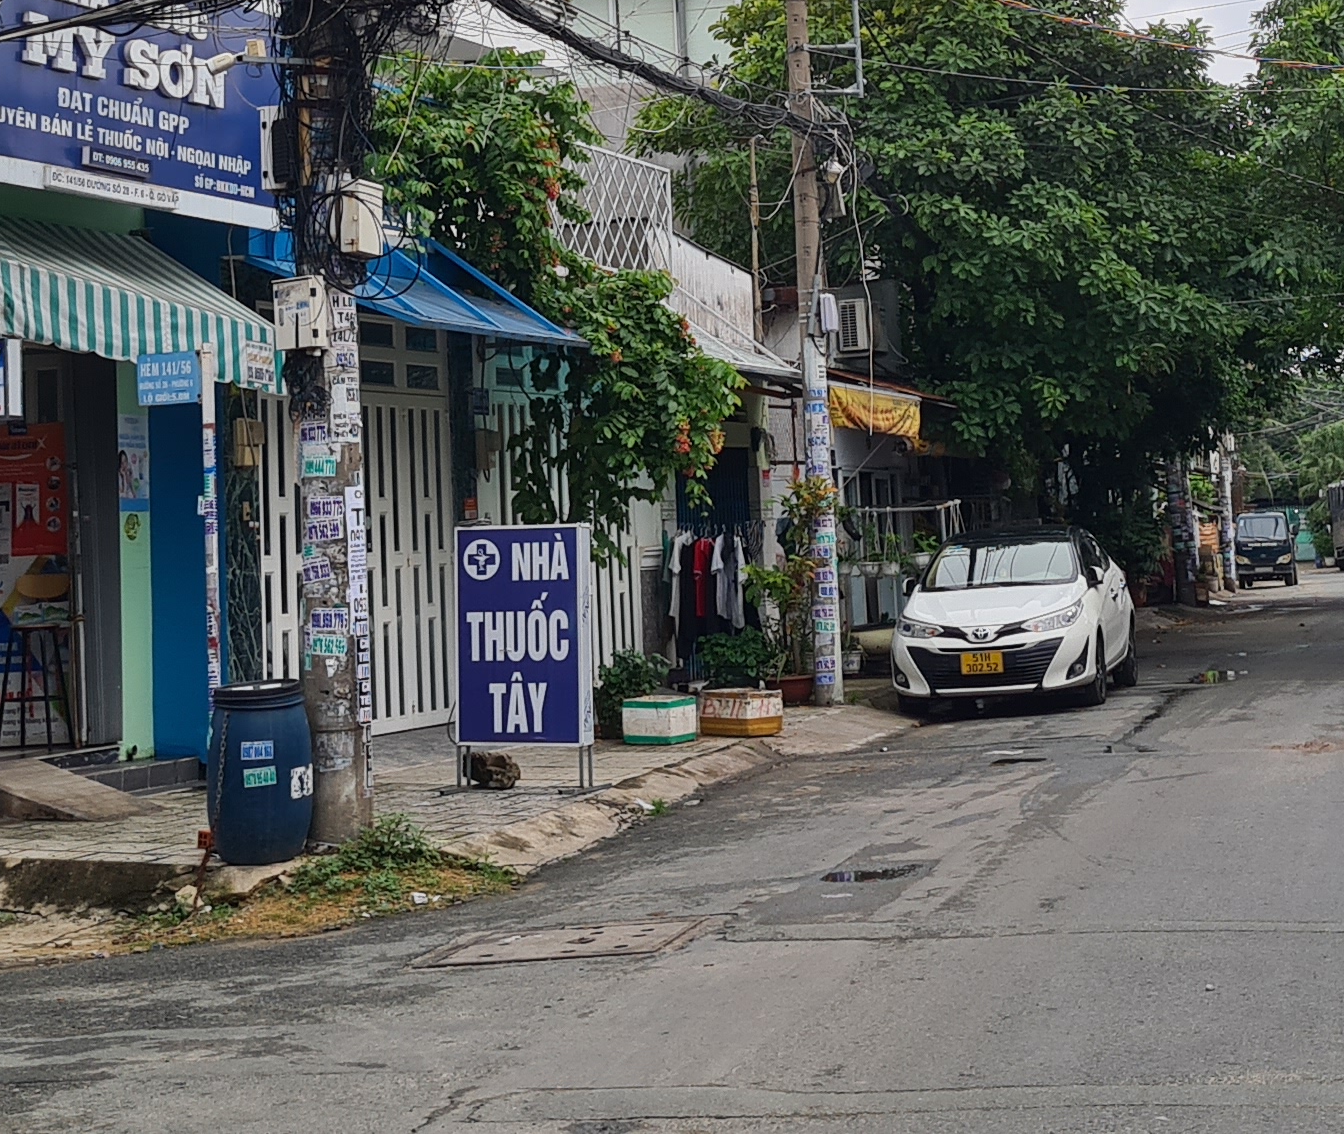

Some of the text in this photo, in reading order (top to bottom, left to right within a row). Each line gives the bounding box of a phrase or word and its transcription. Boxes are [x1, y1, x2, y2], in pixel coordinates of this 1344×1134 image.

[123, 38, 228, 109] SƠN
[58, 86, 190, 135] ĐẠT CHUẨN GPP
[41, 113, 73, 138] BÁN
[76, 118, 94, 142] LẺ
[97, 127, 143, 153] THUỐC
[146, 136, 169, 160] NỘI
[218, 155, 252, 177] NHẬP
[162, 360, 192, 376] 141/56
[511, 532, 569, 581] NHÀ
[466, 591, 570, 662] THUỐC
[972, 652, 991, 662] 51H
[488, 671, 548, 734] TÂY
